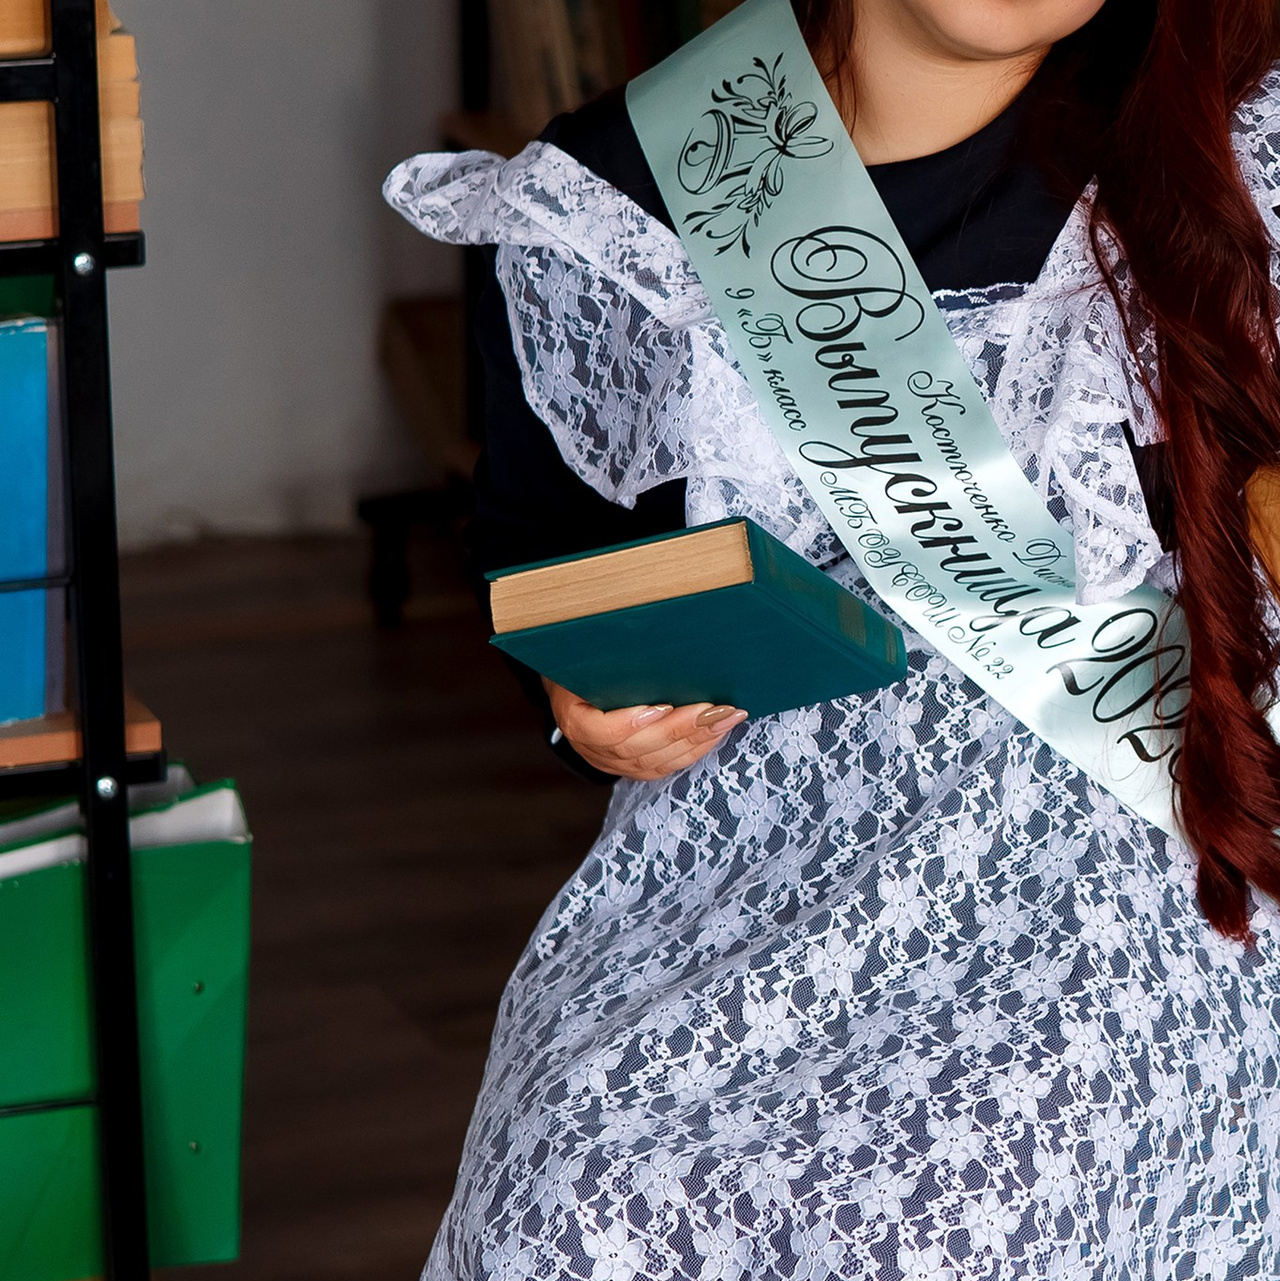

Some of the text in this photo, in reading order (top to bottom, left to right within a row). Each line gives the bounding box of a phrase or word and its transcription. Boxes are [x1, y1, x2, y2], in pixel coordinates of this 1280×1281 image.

[724, 286, 755, 300] 9
[763, 368, 807, 432] класс
[770, 225, 1191, 784] Выпускница 202
[906, 370, 1017, 544] Костюченко
[983, 656, 1015, 681] 22
